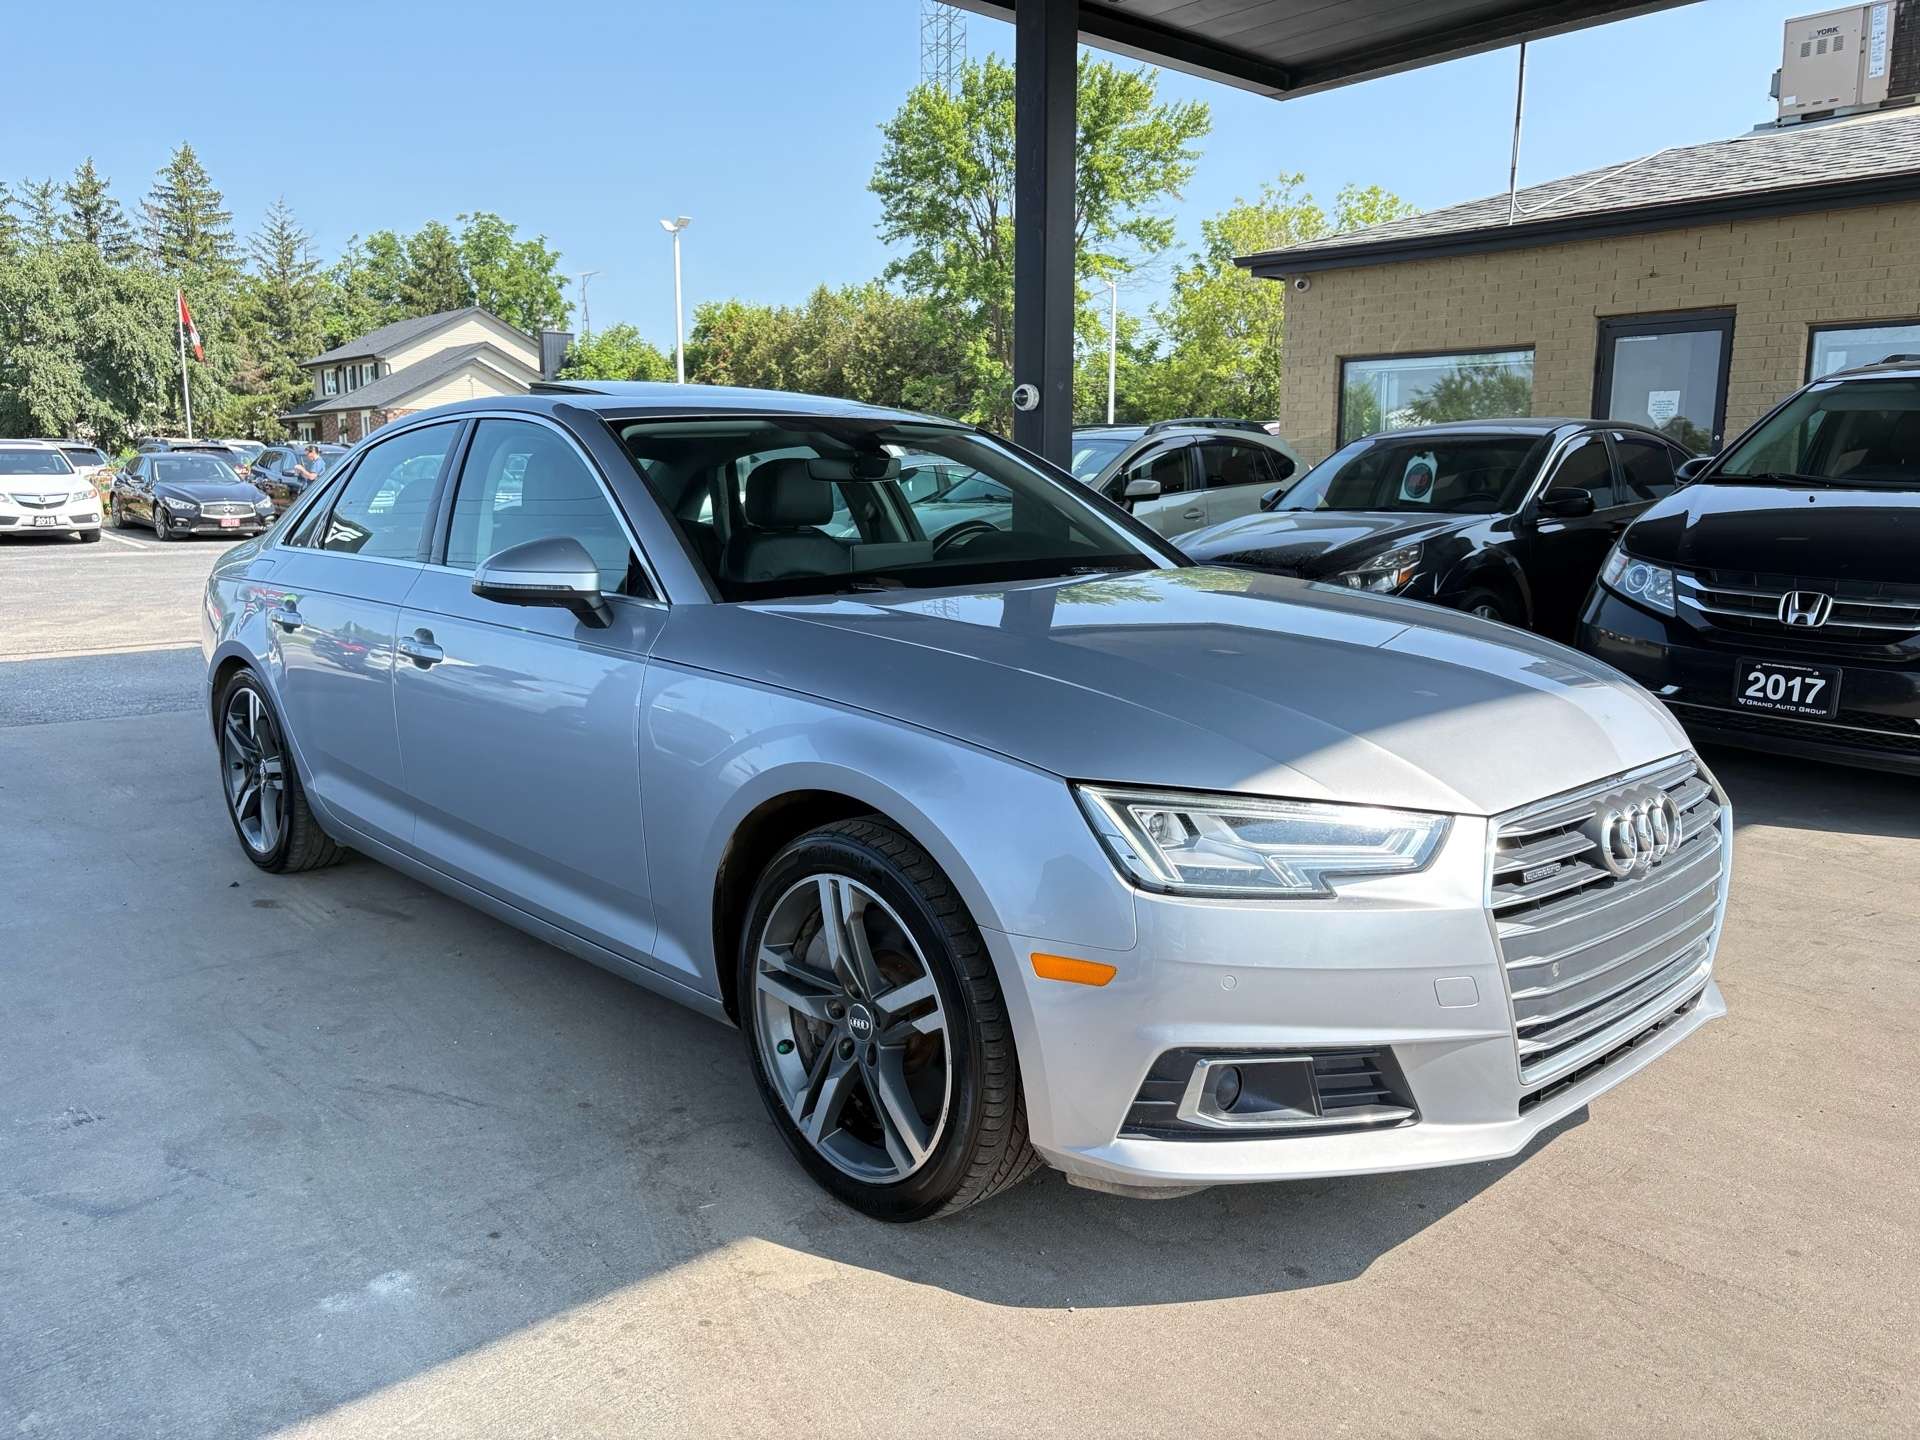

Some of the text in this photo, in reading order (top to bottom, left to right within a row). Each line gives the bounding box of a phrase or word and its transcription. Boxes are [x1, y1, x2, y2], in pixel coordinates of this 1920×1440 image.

[1816, 25, 1840, 36] YORK
[1745, 671, 1826, 704] 2017
[1746, 699, 1827, 715] GRAND AUTO GROUP
